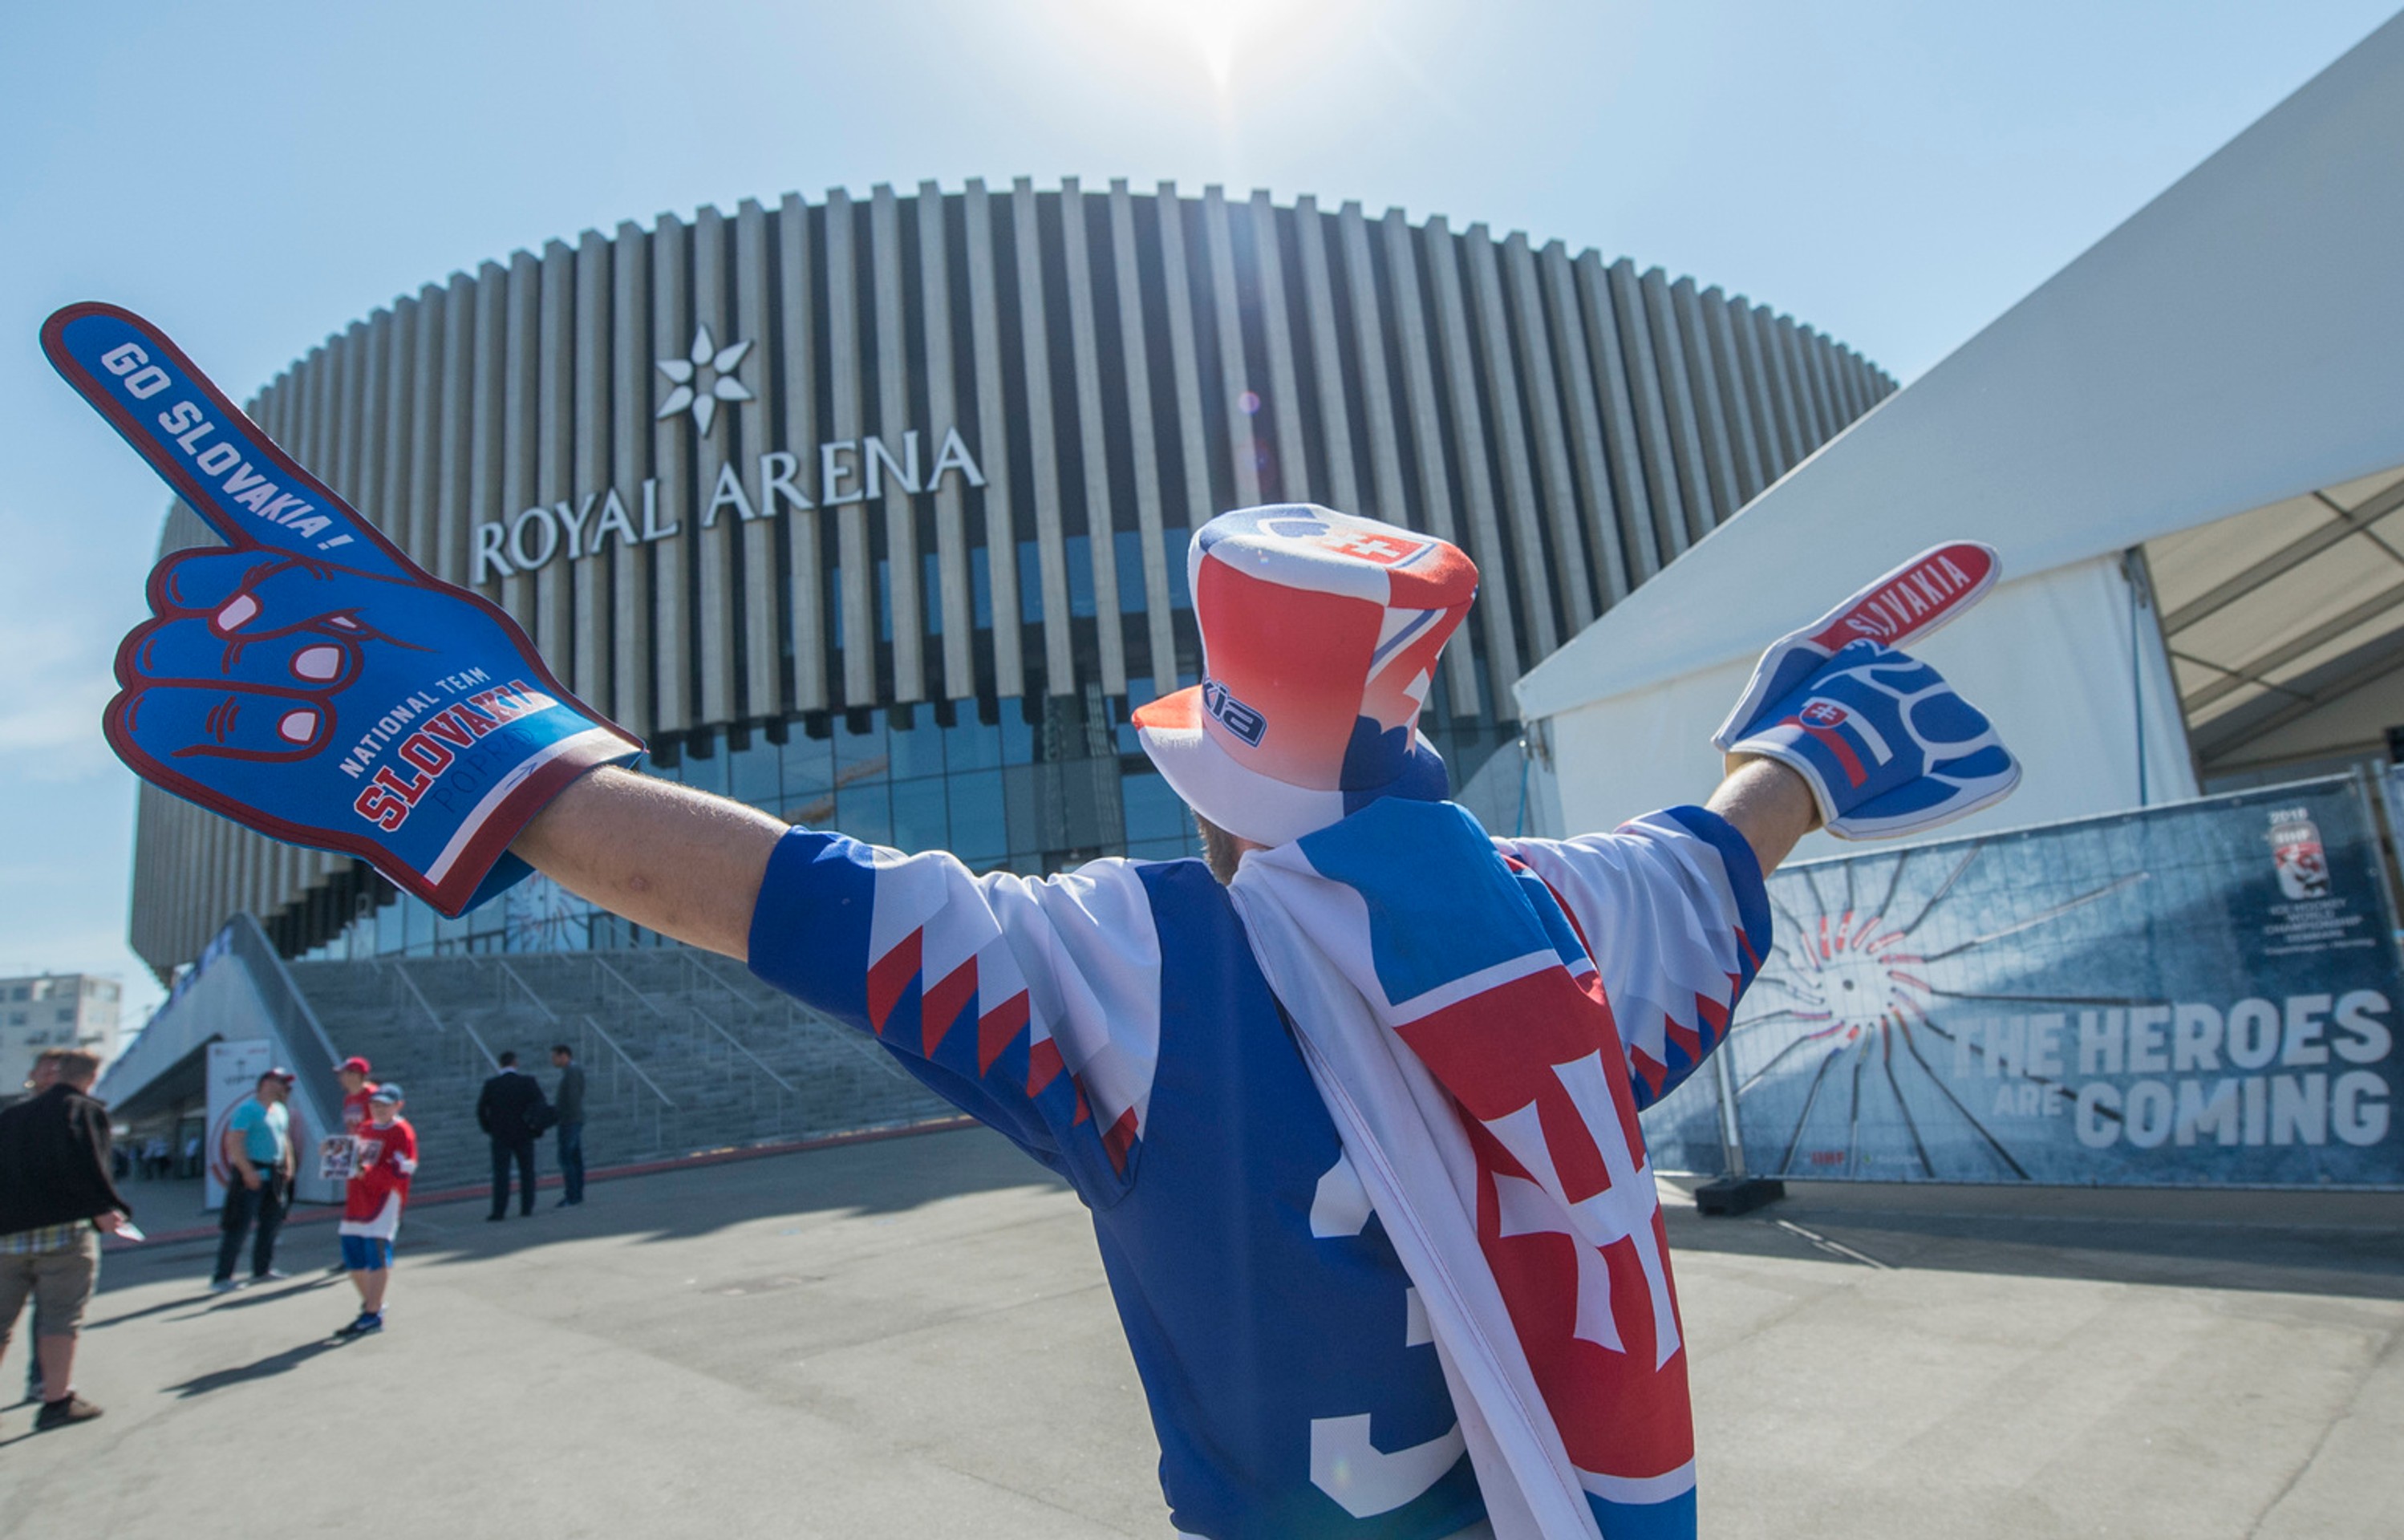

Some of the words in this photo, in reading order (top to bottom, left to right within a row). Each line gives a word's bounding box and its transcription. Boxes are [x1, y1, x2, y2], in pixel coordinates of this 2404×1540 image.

[101, 342, 171, 399] GO
[474, 479, 681, 586] ROYAL
[702, 426, 987, 529] ARENA
[339, 691, 440, 779] NATIONAL
[435, 667, 491, 694] TEAM
[1949, 1013, 2065, 1078] THE
[2078, 989, 2392, 1075] HEROES
[1993, 1084, 2064, 1116] ARE
[2075, 1071, 2390, 1149] COMING
